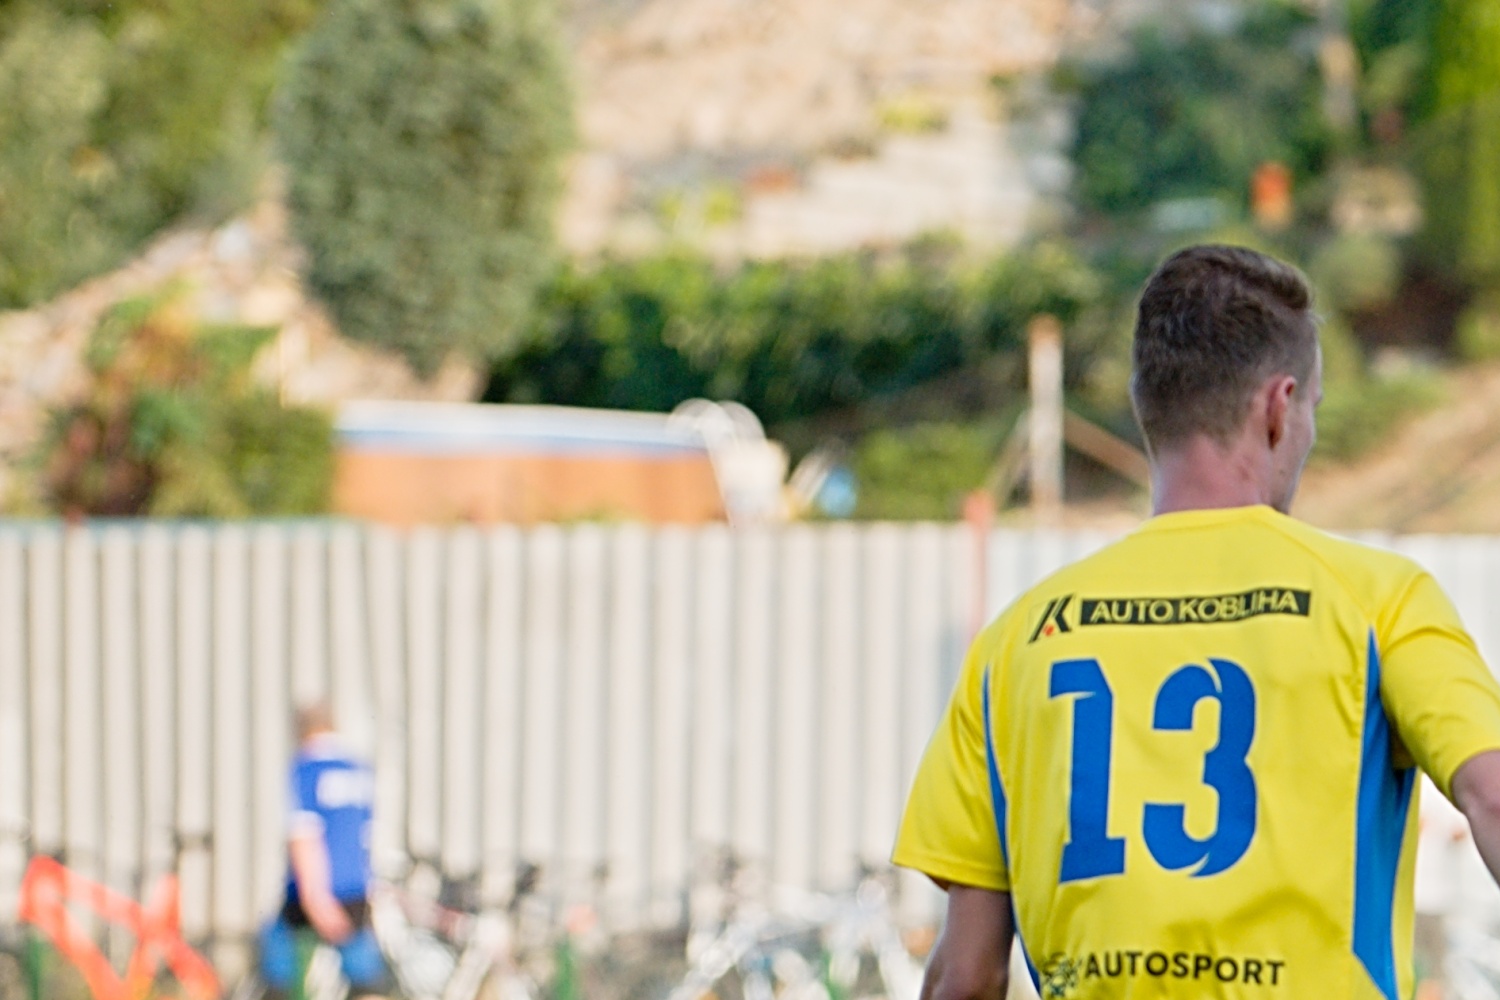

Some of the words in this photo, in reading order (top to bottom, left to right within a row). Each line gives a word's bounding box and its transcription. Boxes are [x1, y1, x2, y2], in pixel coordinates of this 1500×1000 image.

[1090, 598, 1174, 623] AUTO
[1178, 589, 1300, 621] KOBLIHA
[1048, 658, 1258, 885] 13
[1084, 950, 1286, 986] AUTOSPORT
